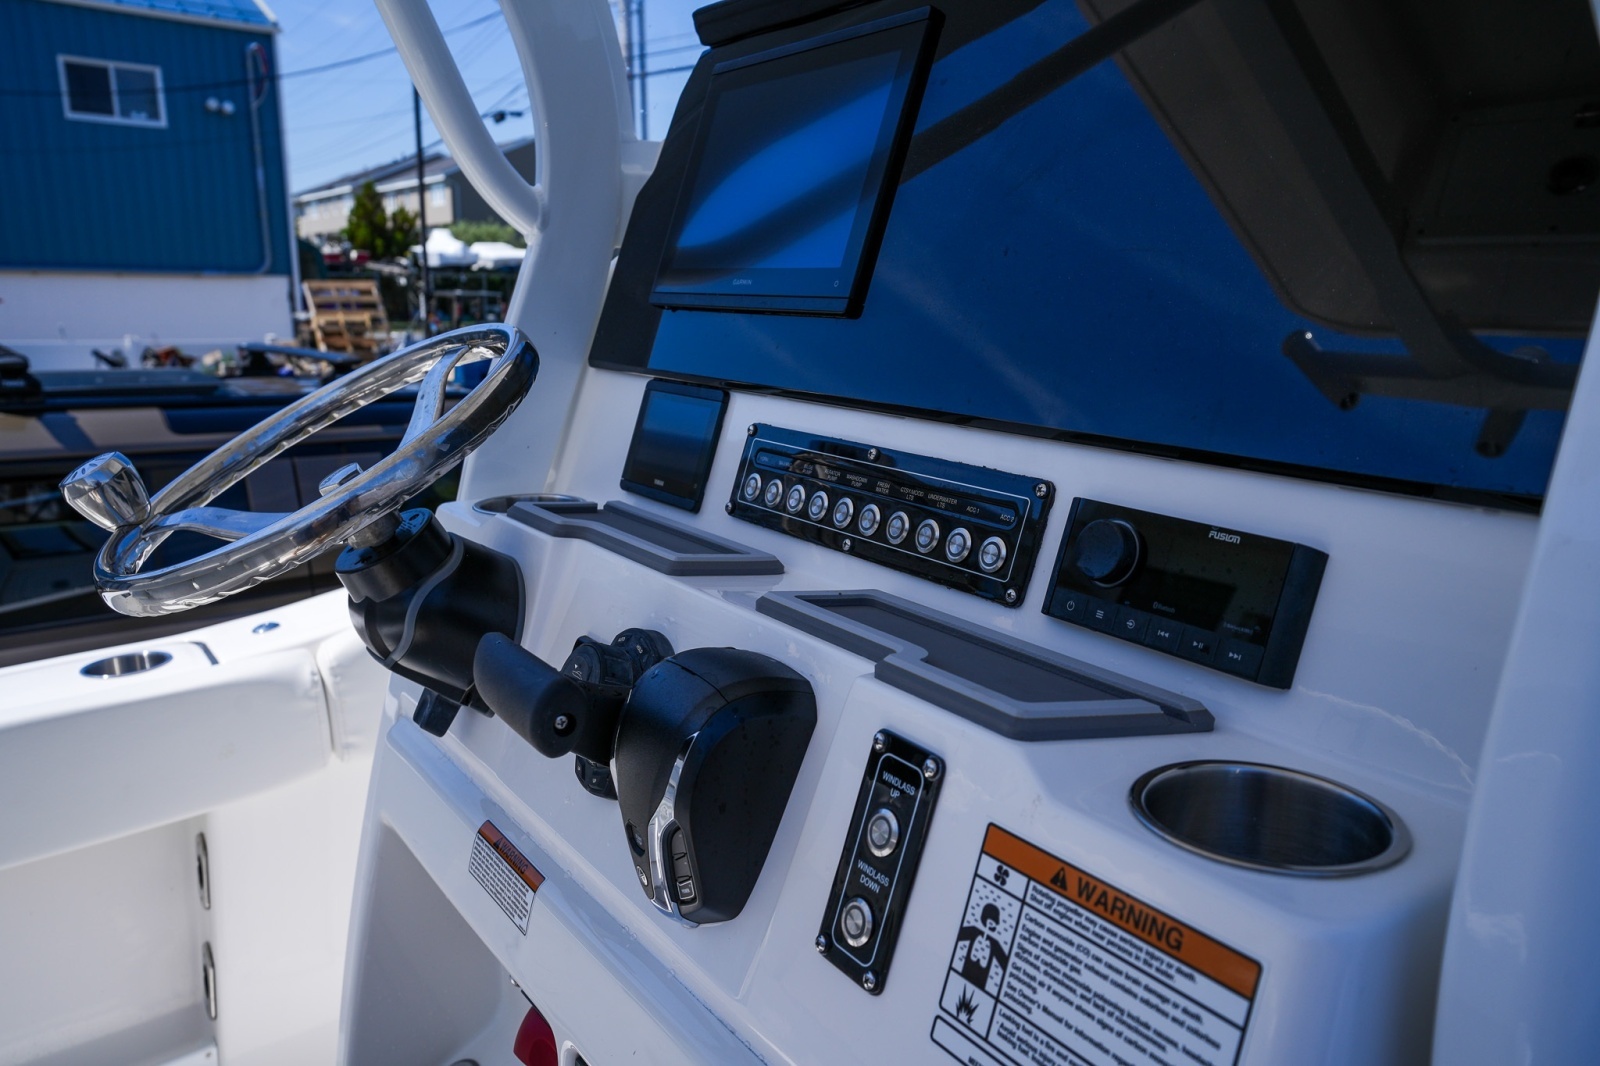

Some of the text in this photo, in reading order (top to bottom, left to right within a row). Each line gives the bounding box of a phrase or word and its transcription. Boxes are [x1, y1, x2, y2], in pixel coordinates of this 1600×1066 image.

[732, 278, 752, 286] GARMIN
[850, 480, 863, 488] PUMP
[875, 486, 890, 494] WATER
[876, 480, 891, 489] FRESH
[905, 493, 915, 501] LTS
[927, 493, 958, 505] UNDERWATER
[936, 501, 946, 509] LTS
[966, 505, 977, 514] ACC
[999, 513, 1010, 522] ACC
[1208, 530, 1241, 545] FUSION
[882, 770, 915, 796] WINDLASS
[890, 788, 901, 799] UP
[499, 842, 529, 875] WARNING
[857, 860, 889, 886] WINDLASS
[859, 876, 881, 894] DOWN
[1076, 875, 1185, 953] WARNING
[1030, 893, 1043, 905] Shut
[1053, 908, 1073, 923] engine
[1074, 920, 1090, 932] when
[1091, 930, 1105, 941] near
[1106, 939, 1133, 957] persons
[1134, 953, 1141, 961] in
[1142, 958, 1153, 968] the
[1154, 966, 1174, 980] water.
[1032, 885, 1196, 982] Rotating propeller may cause serious injury or death.
[1019, 933, 1081, 975] carbon monoxide gas.
[1024, 913, 1202, 1024] Carbon monoxide (CO) can cause brain damage or death.
[1008, 971, 1037, 994] poisoning.
[1017, 942, 1032, 957] Signs
[1040, 958, 1061, 974] carbon
[1062, 972, 1092, 994] monoxide
[1092, 991, 1125, 1016] poisoning
[1126, 1011, 1151, 1031] include
[1021, 923, 1221, 1050] Engine and generator exhaust contains odorless and colorless
[1003, 991, 1032, 1014] poisoning.
[1011, 962, 1022, 972] Get
[1022, 969, 1037, 982] fresh
[1037, 980, 1046, 988] air
[1051, 989, 1074, 1006] anyone
[1075, 1004, 1095, 1021] shows
[1096, 1018, 1114, 1033] signs
[1115, 1030, 1123, 1038] of
[1123, 1036, 1147, 1054] carbon
[1014, 951, 1166, 1052] dizziness, drowsiness, and lack of consciousness.
[1006, 981, 1017, 992] See
[1018, 989, 1040, 1009] Owner's
[1042, 1005, 1064, 1024] Manual
[1064, 1020, 1073, 1030] for
[1074, 1027, 1110, 1055] information
[997, 1029, 1017, 1049] leaking
[999, 1009, 1021, 1030] Leaking
[1021, 1024, 1033, 1037] fuel
[1033, 1033, 1039, 1042] is
[1044, 1041, 1055, 1053] fire
[1055, 1050, 1068, 1062] and
[999, 1022, 1016, 1038] Avoid
[1016, 1035, 1038, 1054] serious
